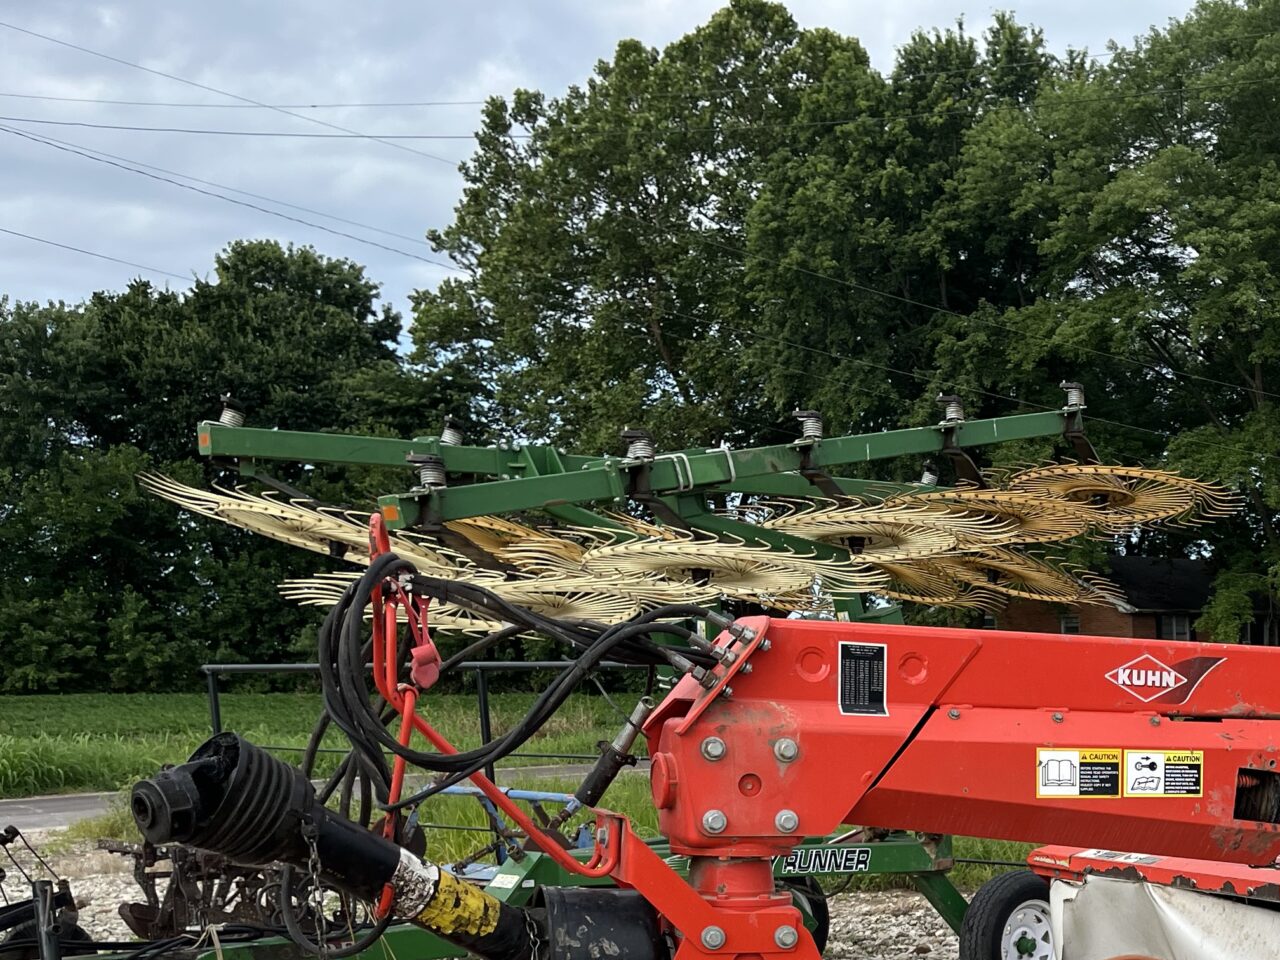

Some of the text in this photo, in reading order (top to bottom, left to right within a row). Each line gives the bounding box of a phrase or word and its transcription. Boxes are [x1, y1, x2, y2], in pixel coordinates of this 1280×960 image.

[1117, 667, 1176, 688] KUHN
[1088, 753, 1119, 761] CAUTION
[1172, 755, 1201, 763] CAUTION
[782, 848, 871, 874] RUNNER
